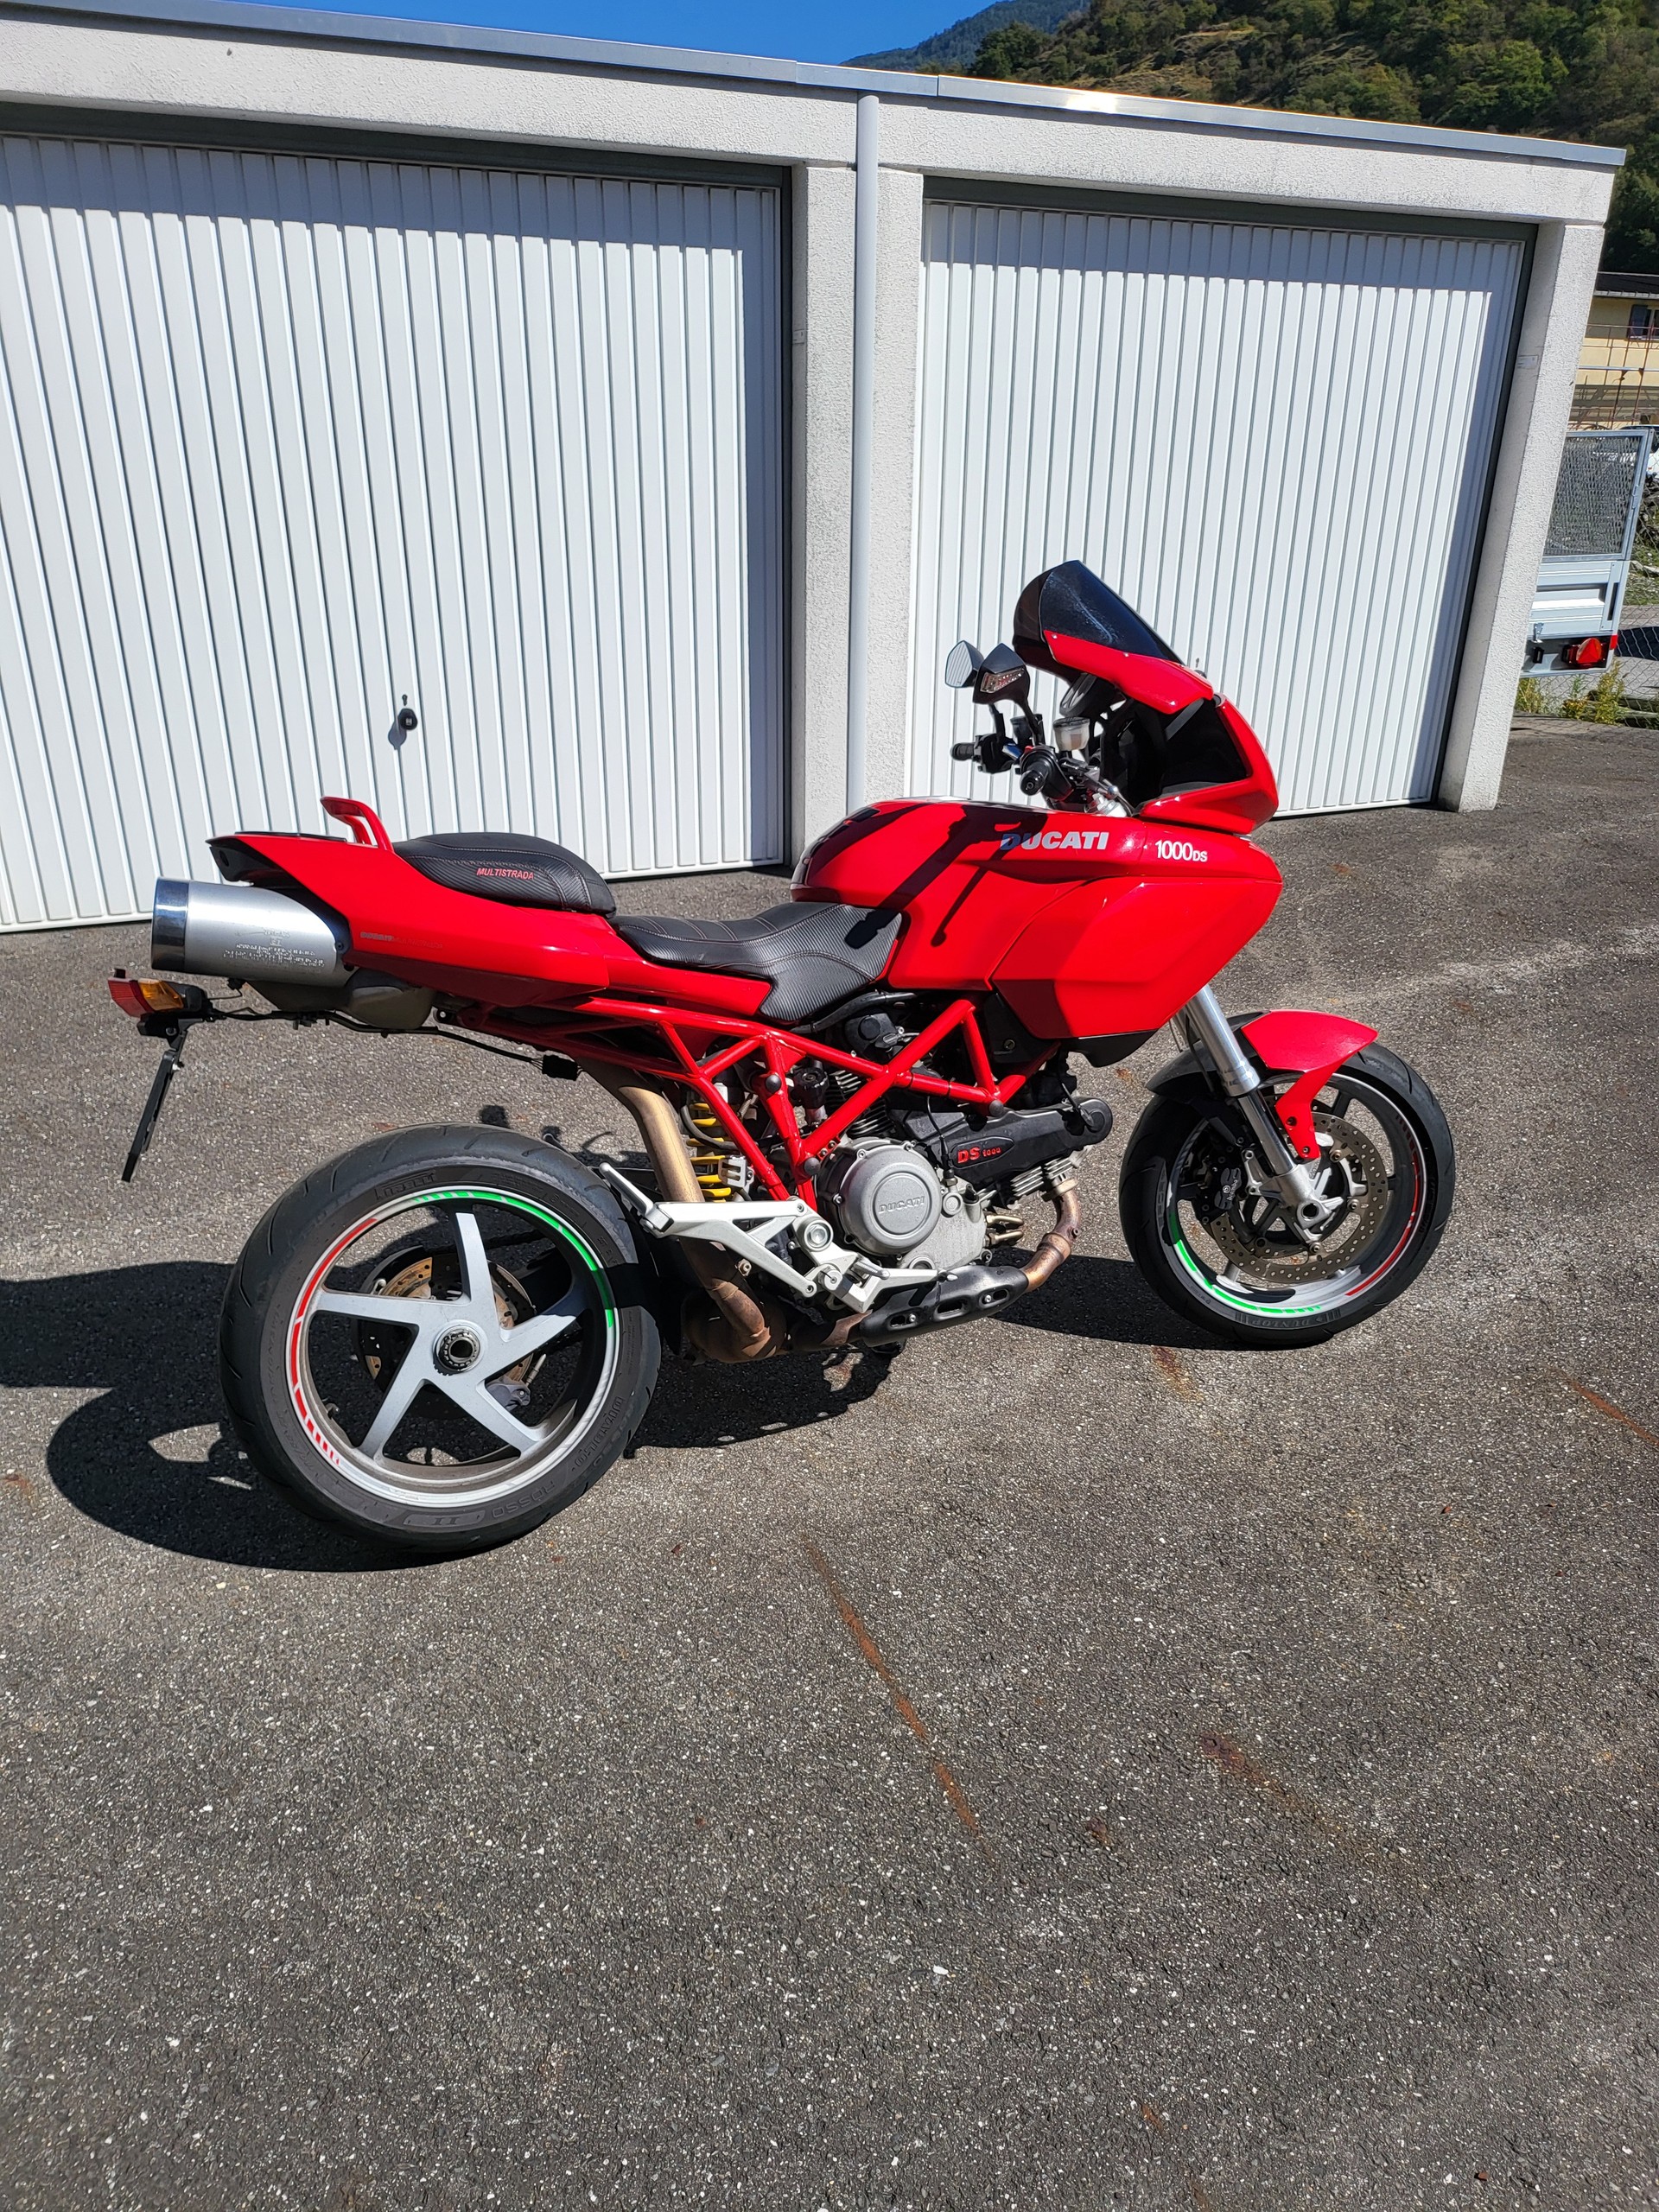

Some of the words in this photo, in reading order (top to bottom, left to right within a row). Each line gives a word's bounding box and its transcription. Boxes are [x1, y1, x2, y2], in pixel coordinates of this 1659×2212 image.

[1000, 831, 1109, 850] DUCATI
[476, 868, 534, 880] MULTISTRADA
[957, 1147, 981, 1164] DS
[878, 1196, 925, 1214] DUCATI
[1252, 1319, 1311, 1328] DUNLOP
[492, 1480, 556, 1518] ROSSO
